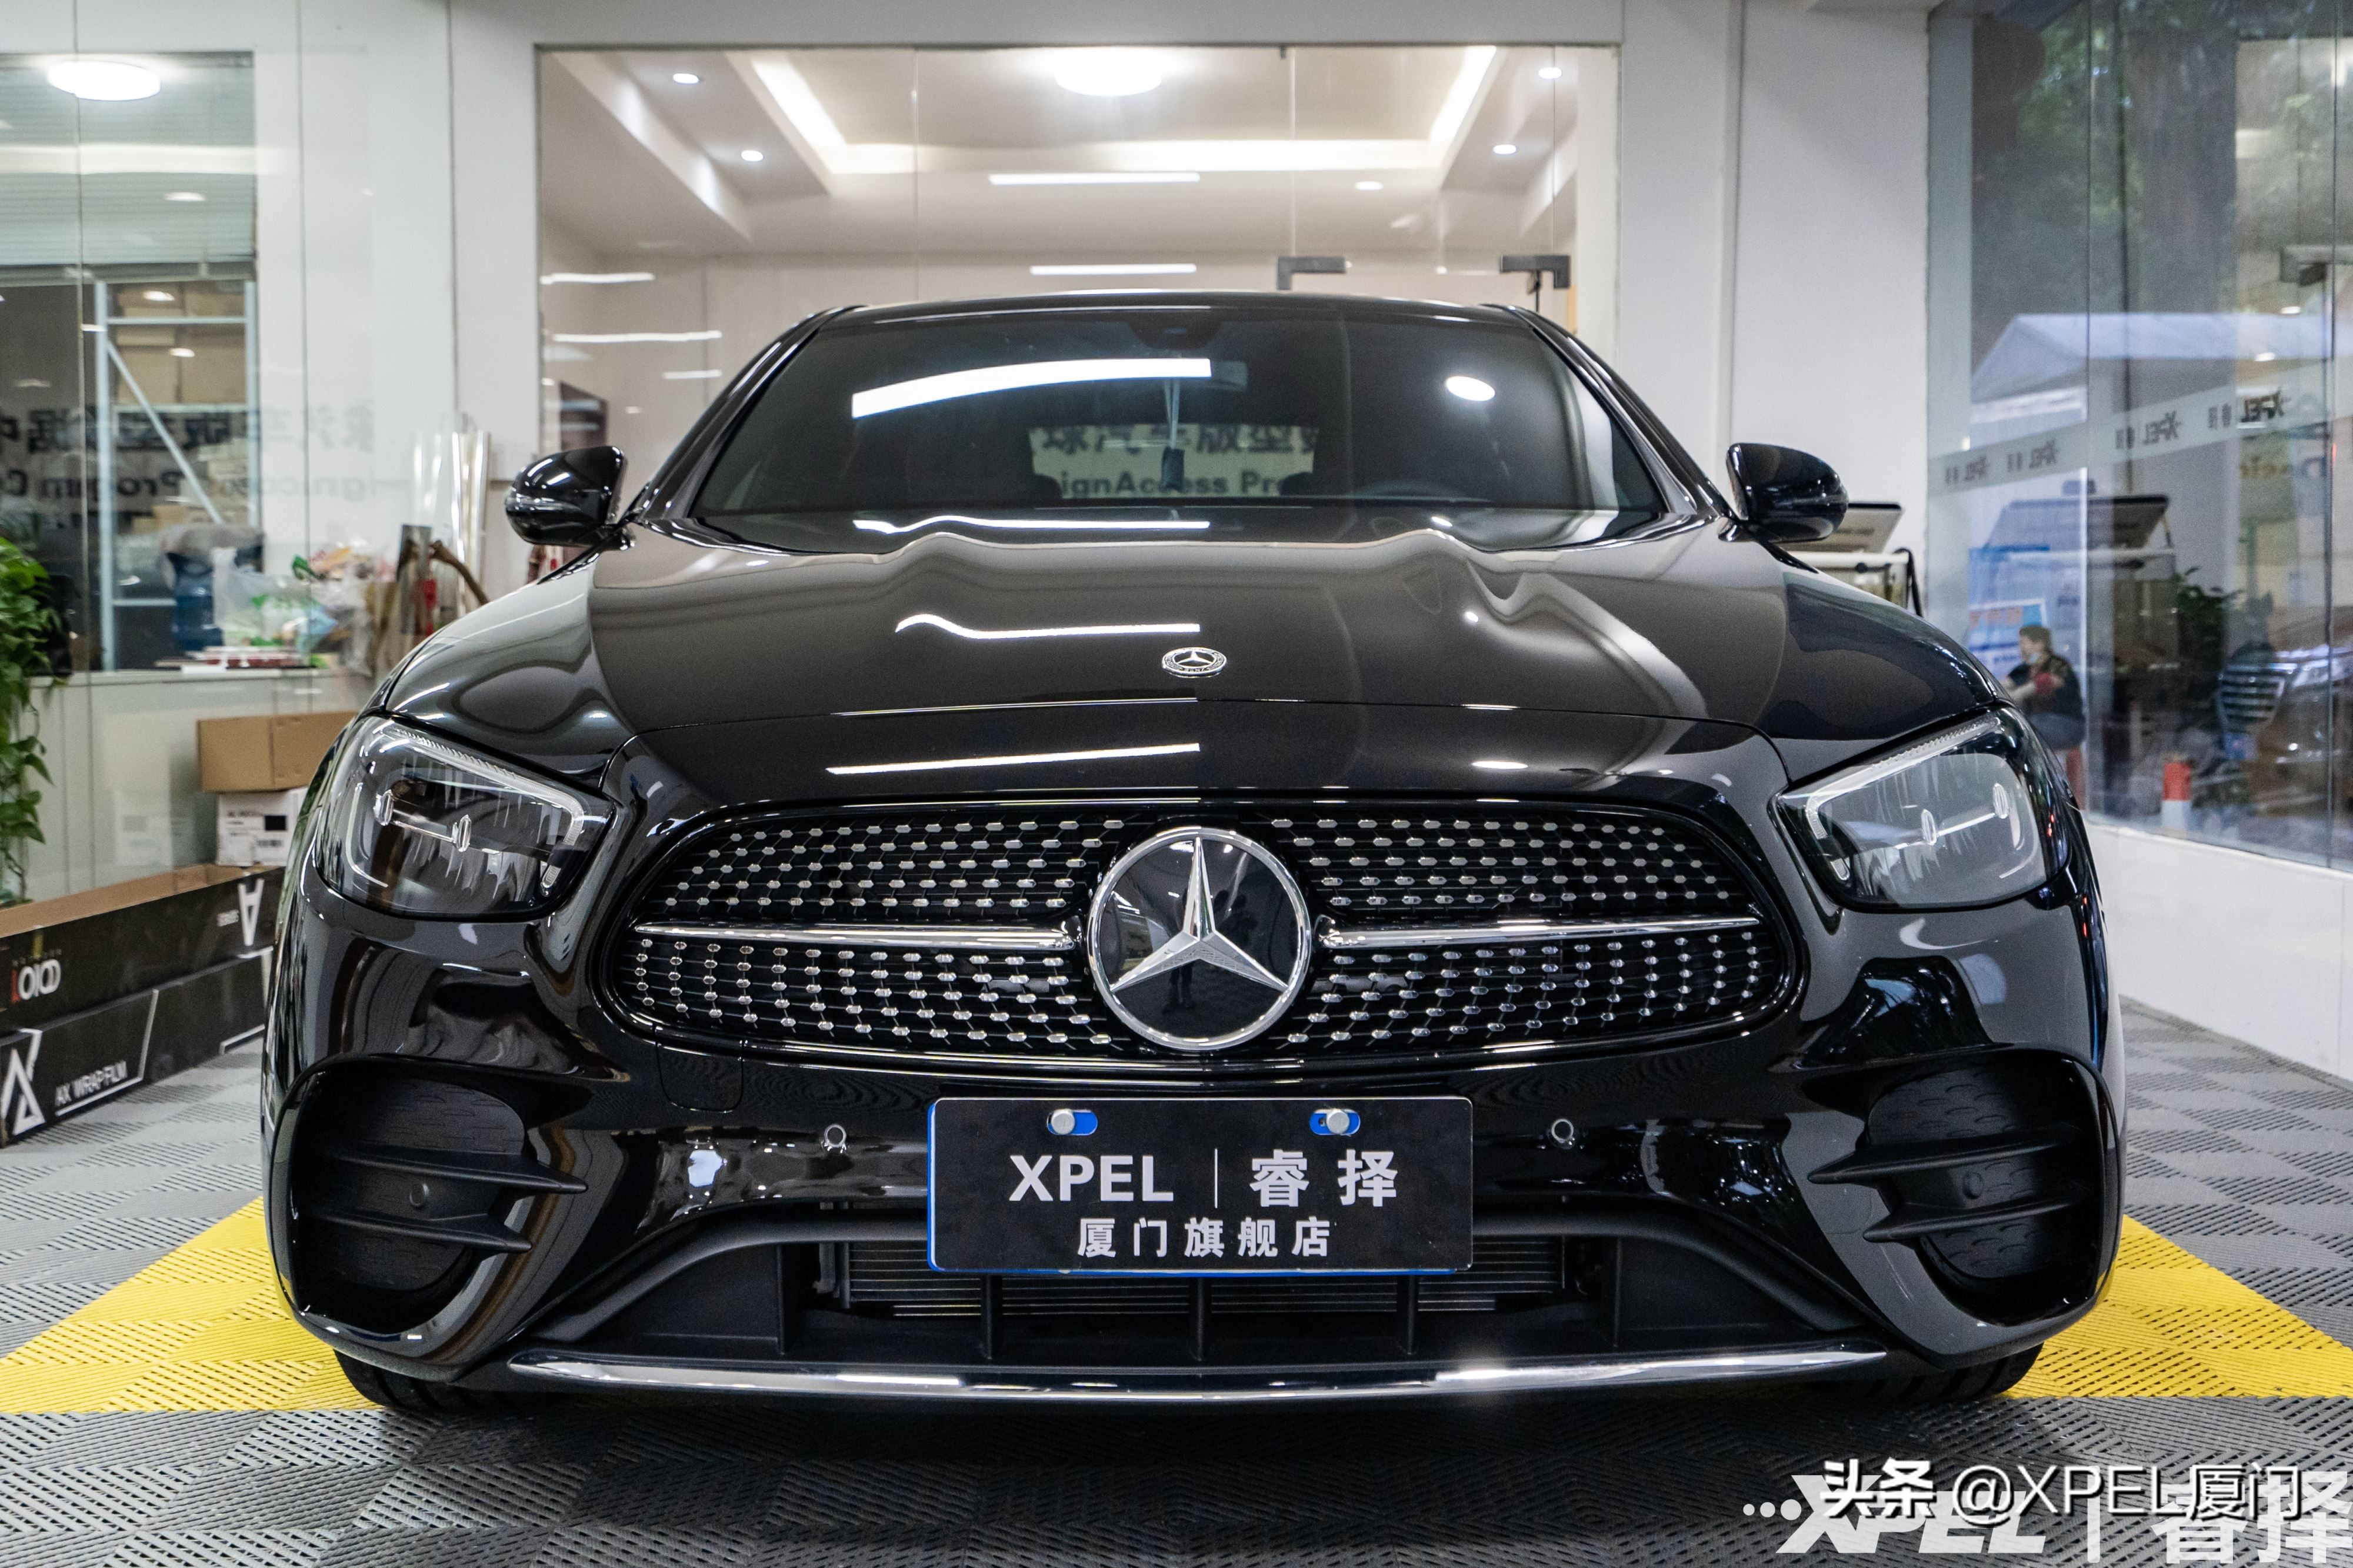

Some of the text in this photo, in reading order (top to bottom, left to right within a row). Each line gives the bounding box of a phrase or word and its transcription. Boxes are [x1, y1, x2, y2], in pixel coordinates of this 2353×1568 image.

[1009, 1149, 1398, 1207] XPEL 睿择
[1077, 1216, 1331, 1258] 厦门旗舰店
